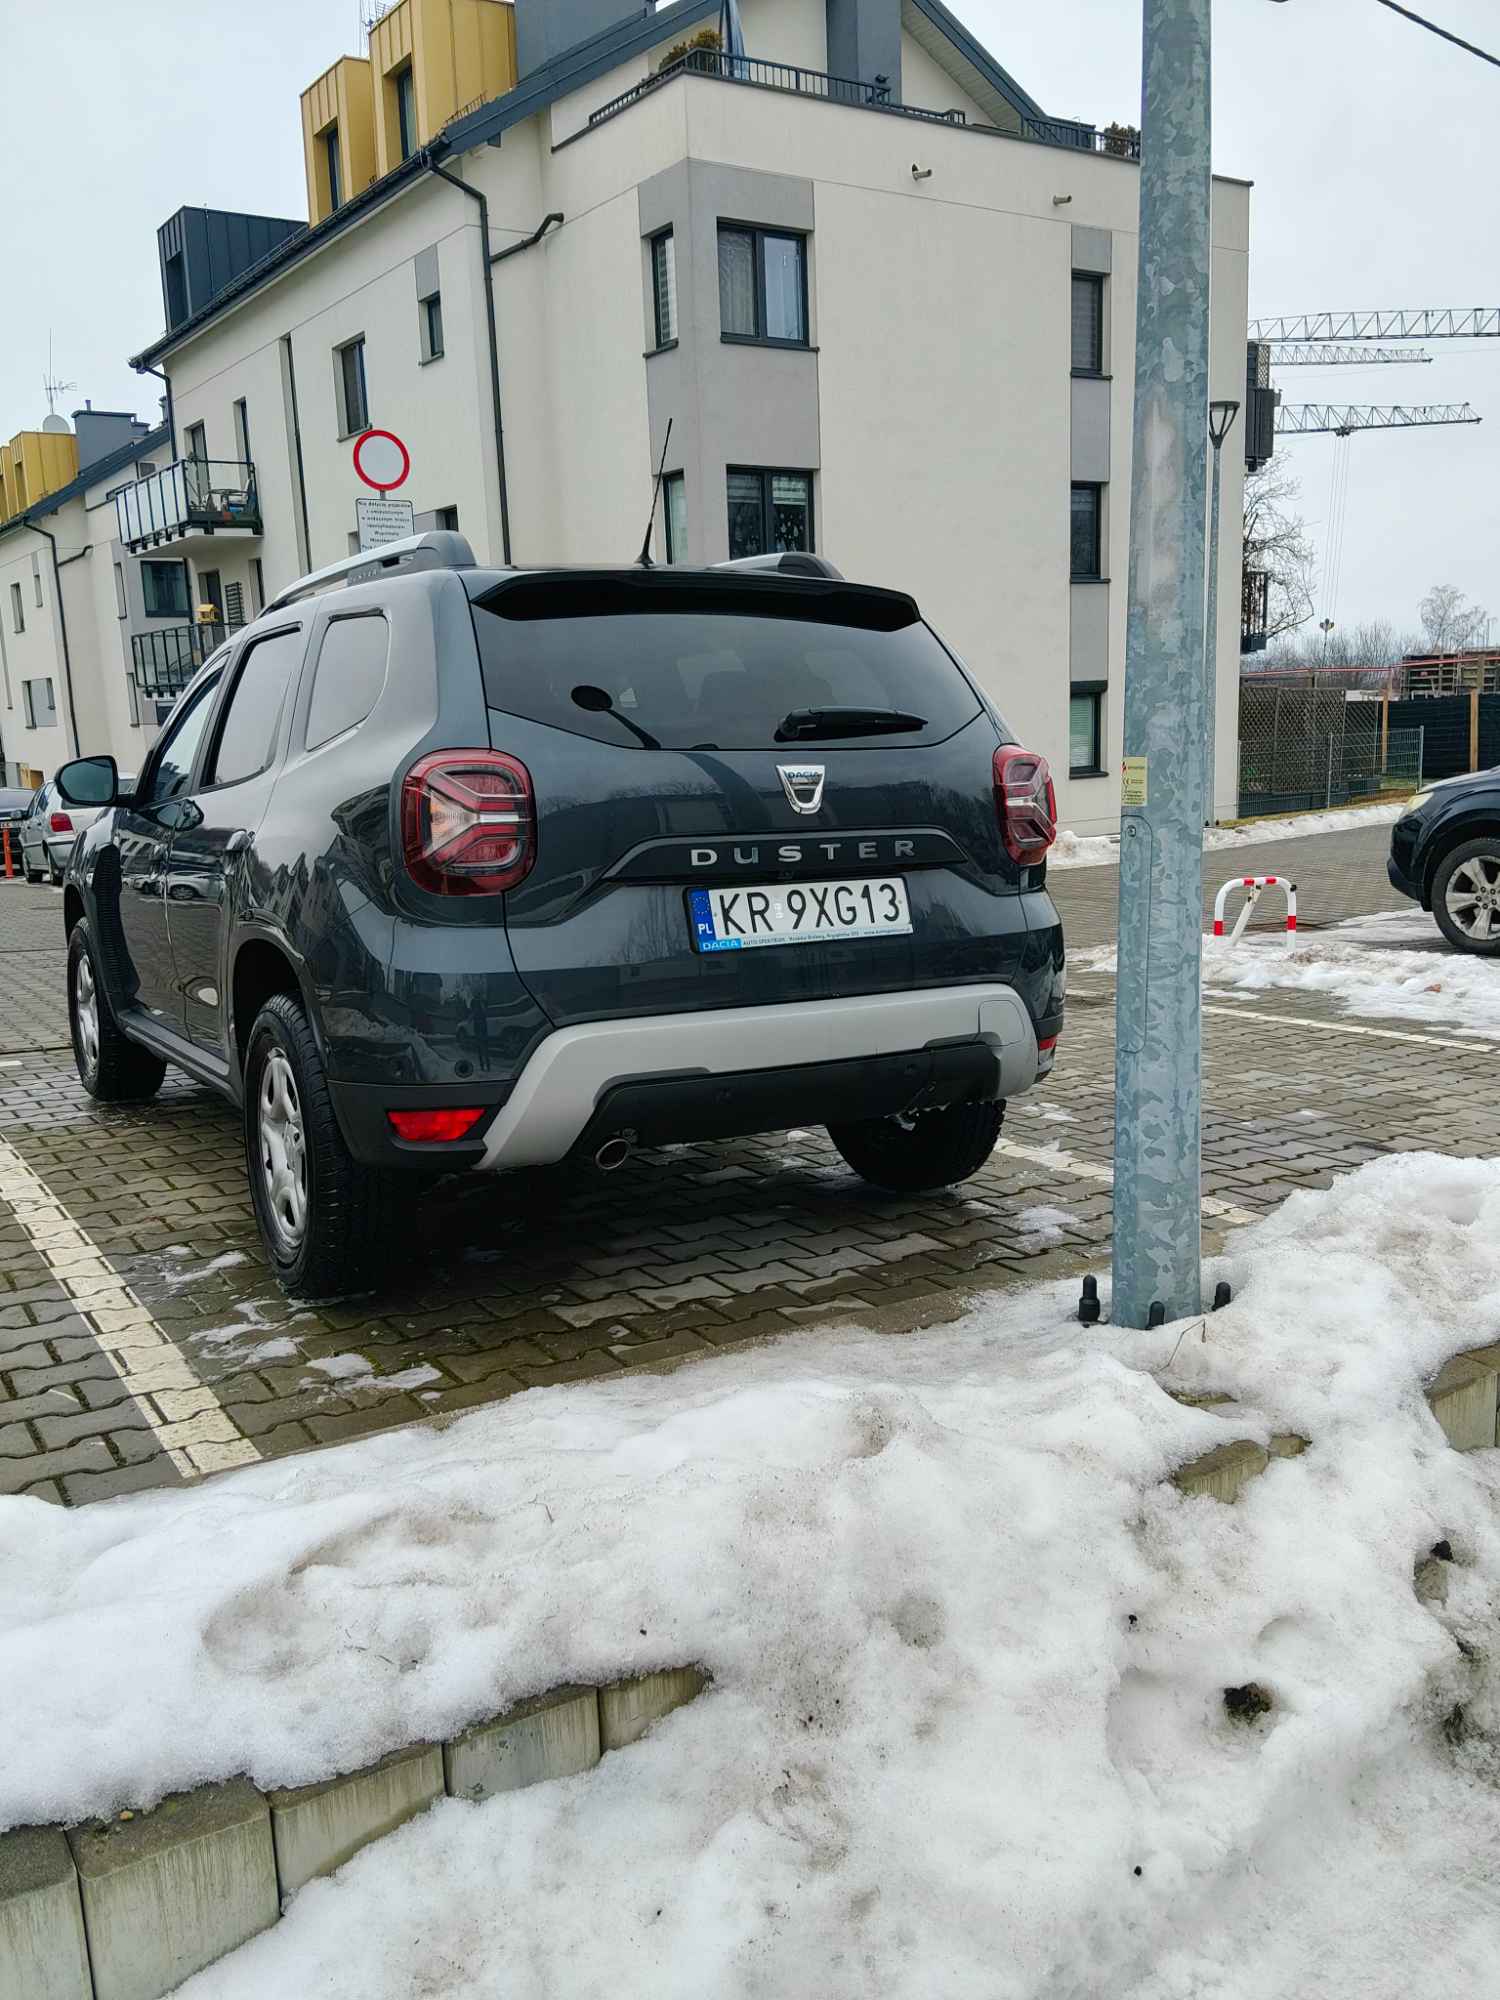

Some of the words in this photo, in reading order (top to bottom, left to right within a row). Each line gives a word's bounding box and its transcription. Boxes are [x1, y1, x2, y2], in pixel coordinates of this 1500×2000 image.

[690, 840, 916, 866] DUSTER
[719, 891, 774, 935] KR
[786, 883, 900, 930] 9XG13
[698, 923, 713, 935] PL
[702, 940, 739, 951] DACIA
